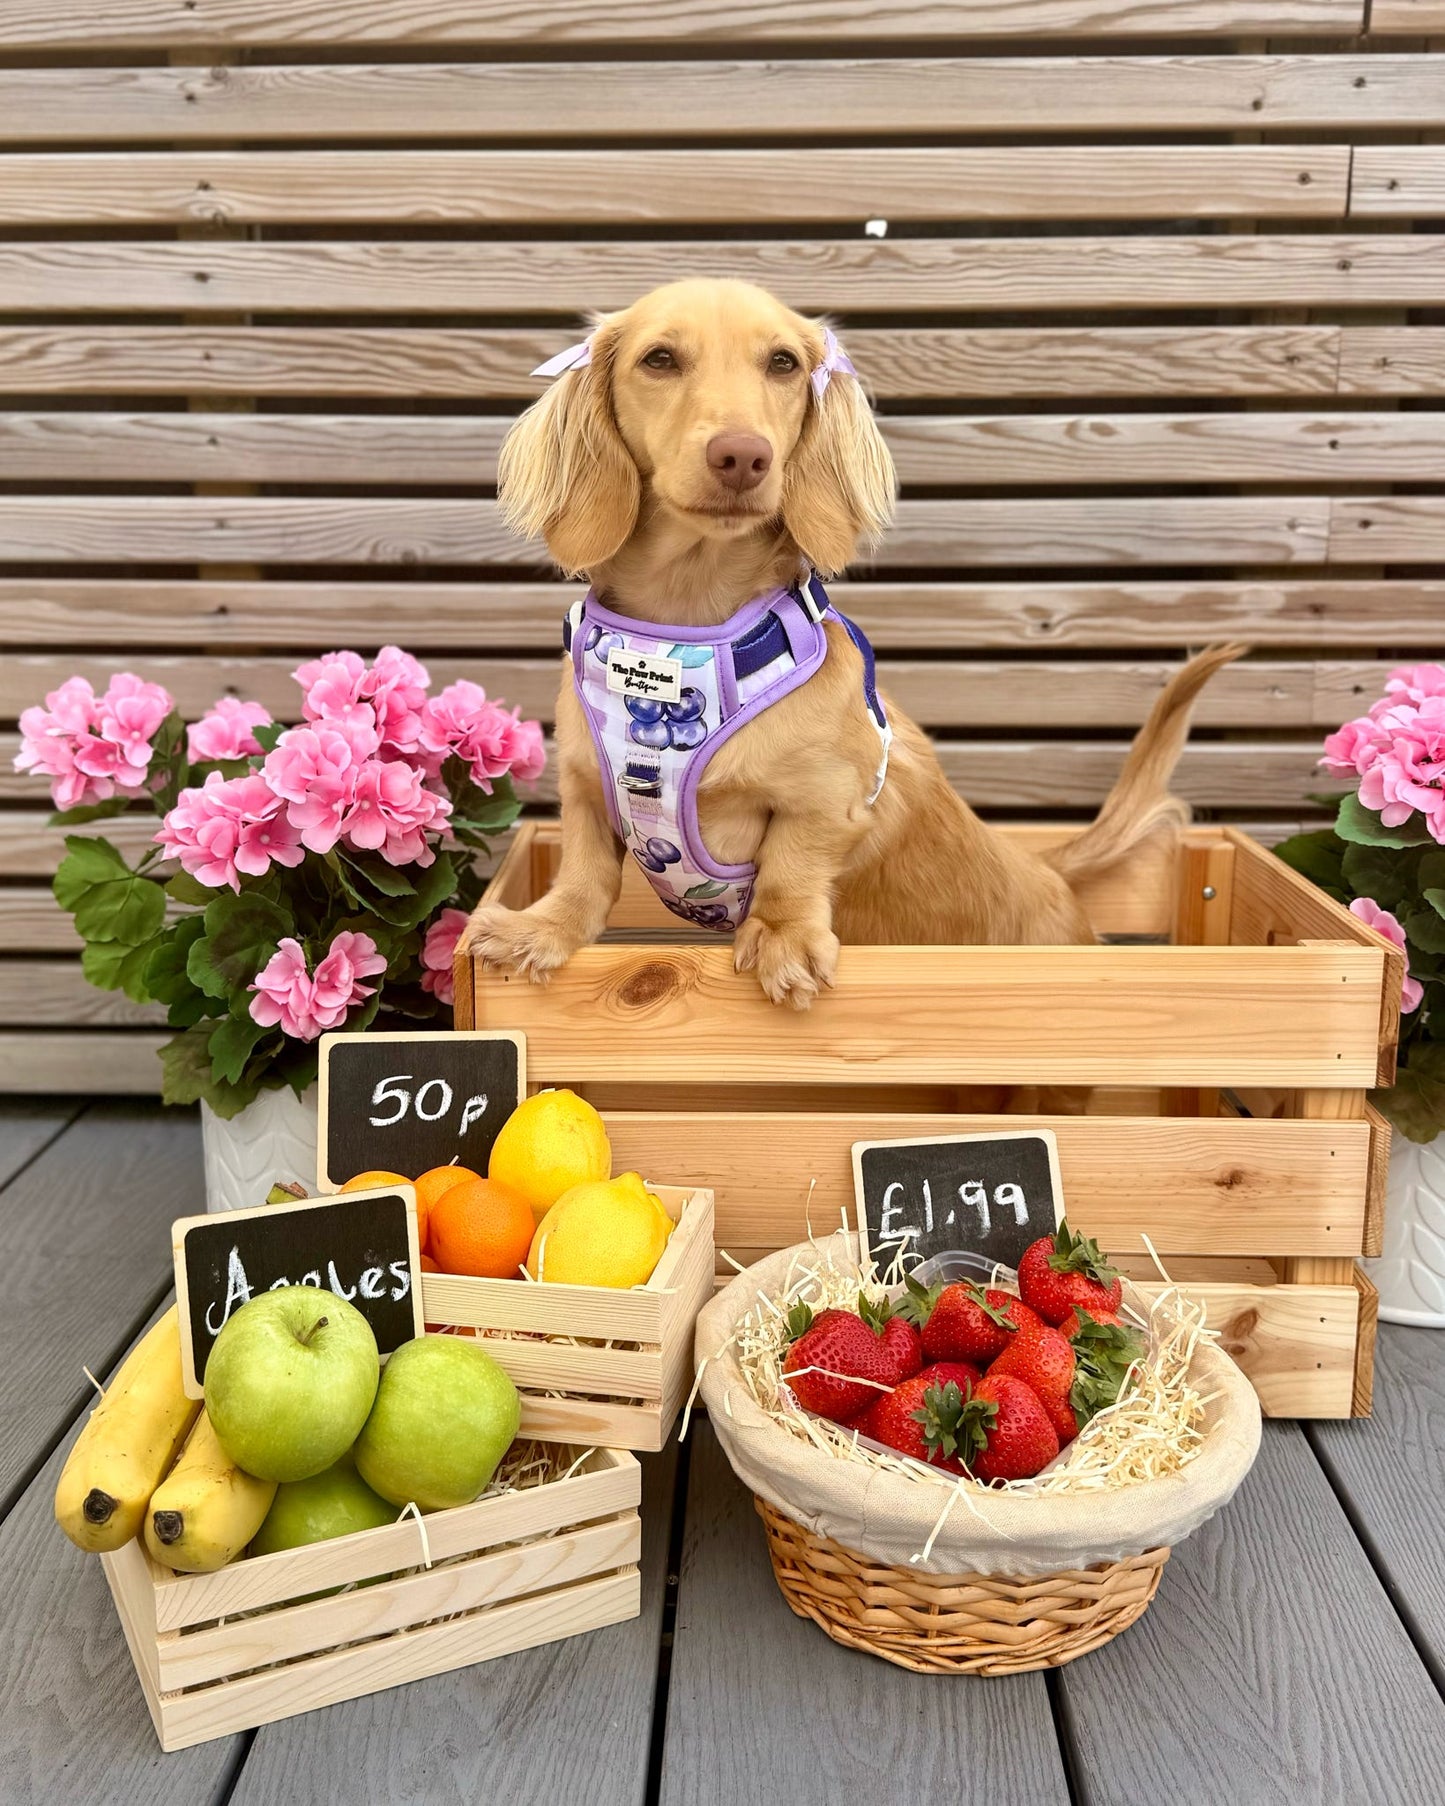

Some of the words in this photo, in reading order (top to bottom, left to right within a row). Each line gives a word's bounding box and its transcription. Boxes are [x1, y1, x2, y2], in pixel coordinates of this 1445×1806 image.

[612, 663, 628, 675] The
[629, 667, 648, 679] Paw
[649, 671, 674, 683] Print
[624, 676, 659, 693] Boutique
[369, 1075, 488, 1137] 50p
